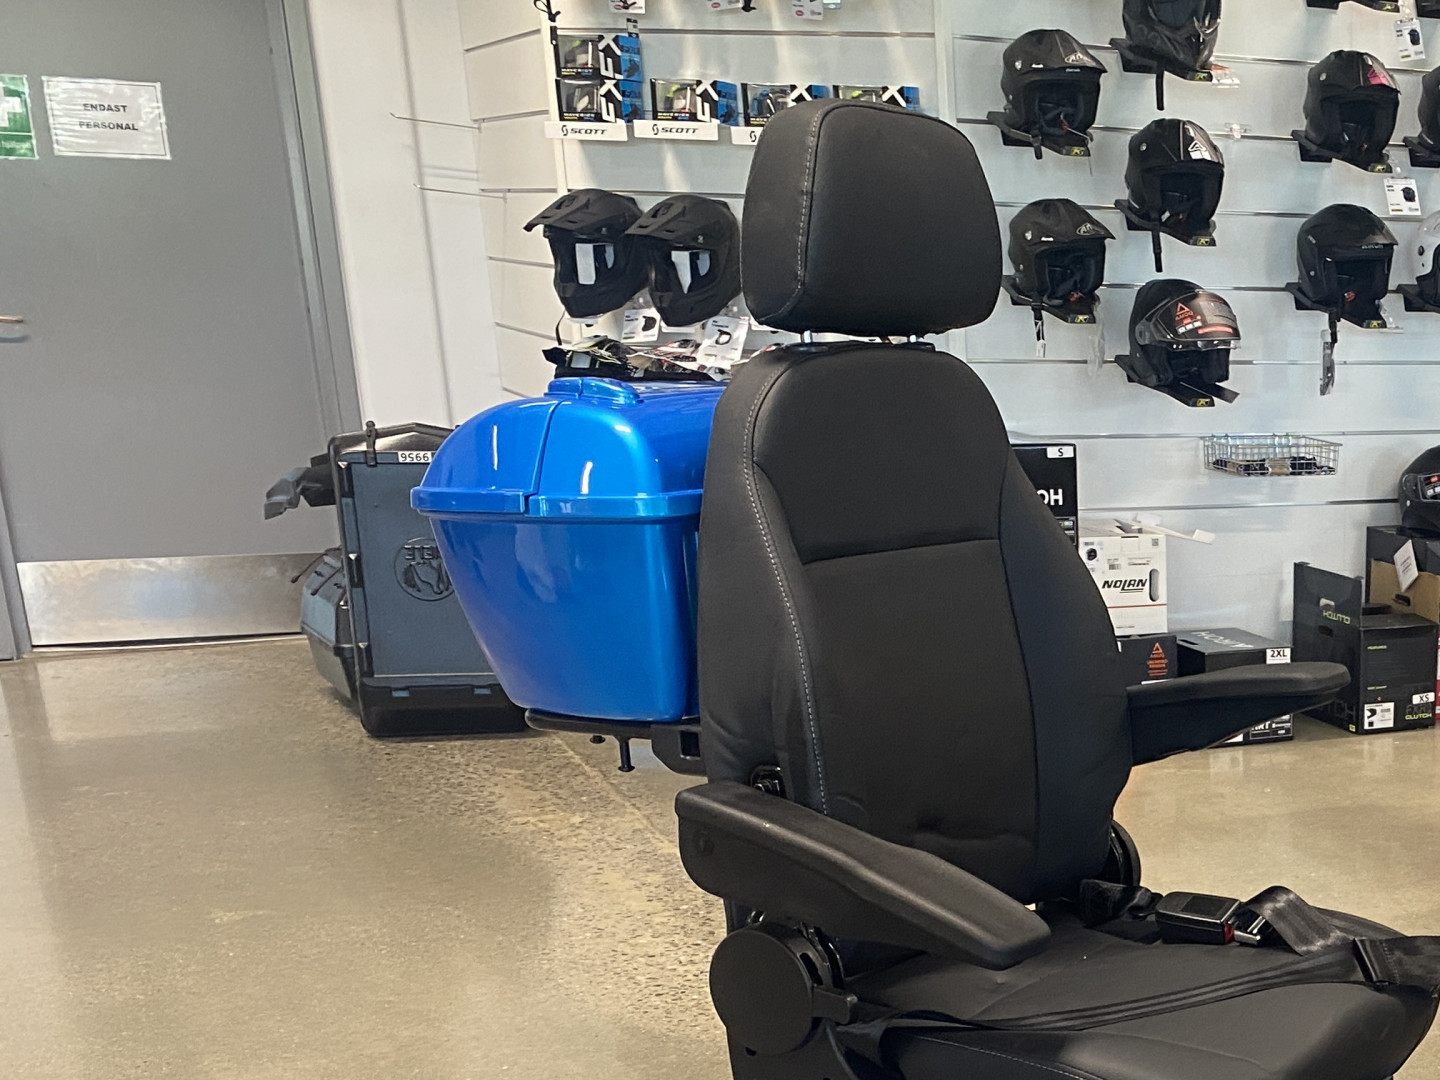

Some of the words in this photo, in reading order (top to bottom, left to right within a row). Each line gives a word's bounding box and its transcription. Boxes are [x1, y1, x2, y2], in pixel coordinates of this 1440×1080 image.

[83, 103, 128, 113] ENDAST
[78, 121, 139, 131] PERSONAL
[570, 127, 607, 135] SCOTT
[661, 126, 699, 134] SCOTT
[400, 452, 430, 462] 9956
[1057, 447, 1064, 457] S
[1101, 578, 1148, 592] NOLAN
[1322, 610, 1351, 625] CLUTCH
[1270, 649, 1288, 658] 2XL
[1419, 694, 1430, 703] XS
[1404, 712, 1433, 721] CLUTCH
